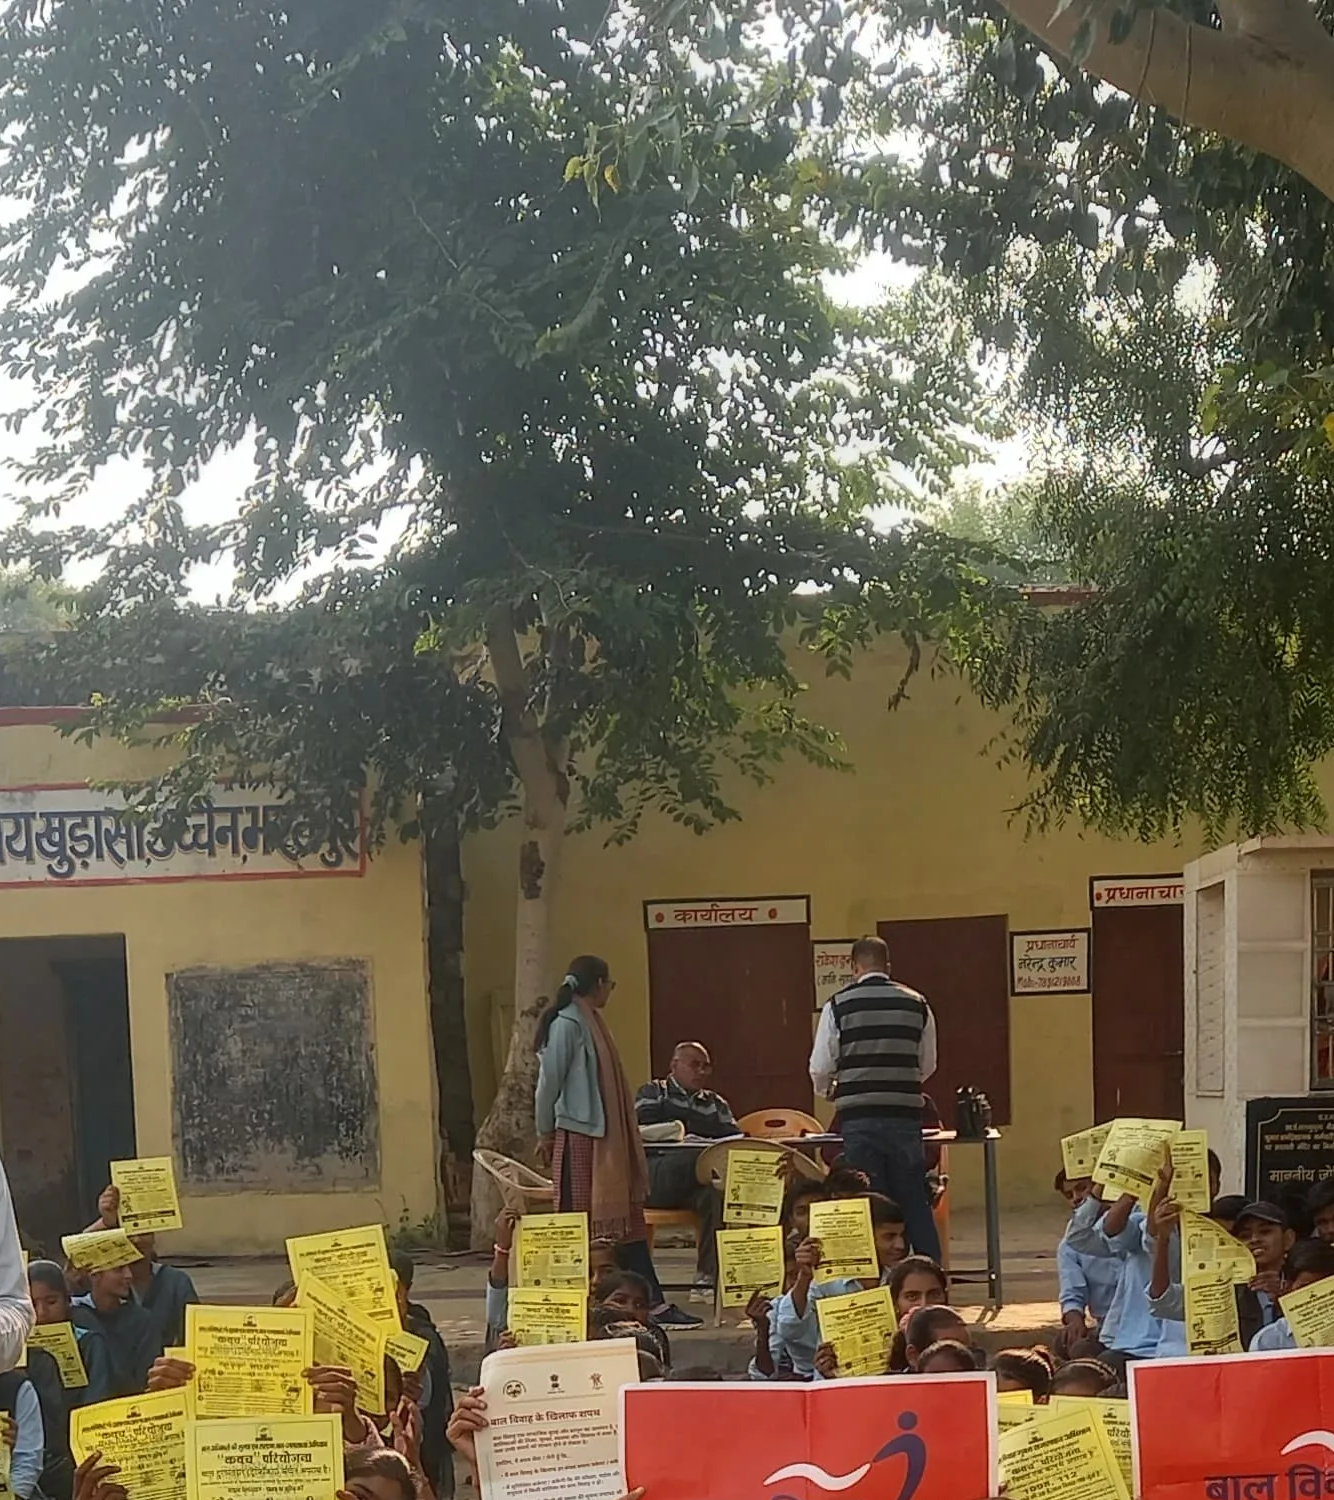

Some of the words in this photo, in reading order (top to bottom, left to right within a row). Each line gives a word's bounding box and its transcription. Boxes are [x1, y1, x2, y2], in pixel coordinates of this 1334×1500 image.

[674, 904, 759, 924] कार्यालय
[1026, 935, 1079, 953] प्रधानाचार्य
[1018, 954, 1046, 972] नरेन्द्र
[1048, 955, 1077, 973] कुमार
[490, 1417, 508, 1426] बाल
[509, 1414, 534, 1424] विवाह
[536, 1411, 544, 1422] के
[546, 1411, 577, 1422] खिलाफ
[262, 1451, 312, 1464] परियोजना
[1058, 1472, 1077, 1482] 112
